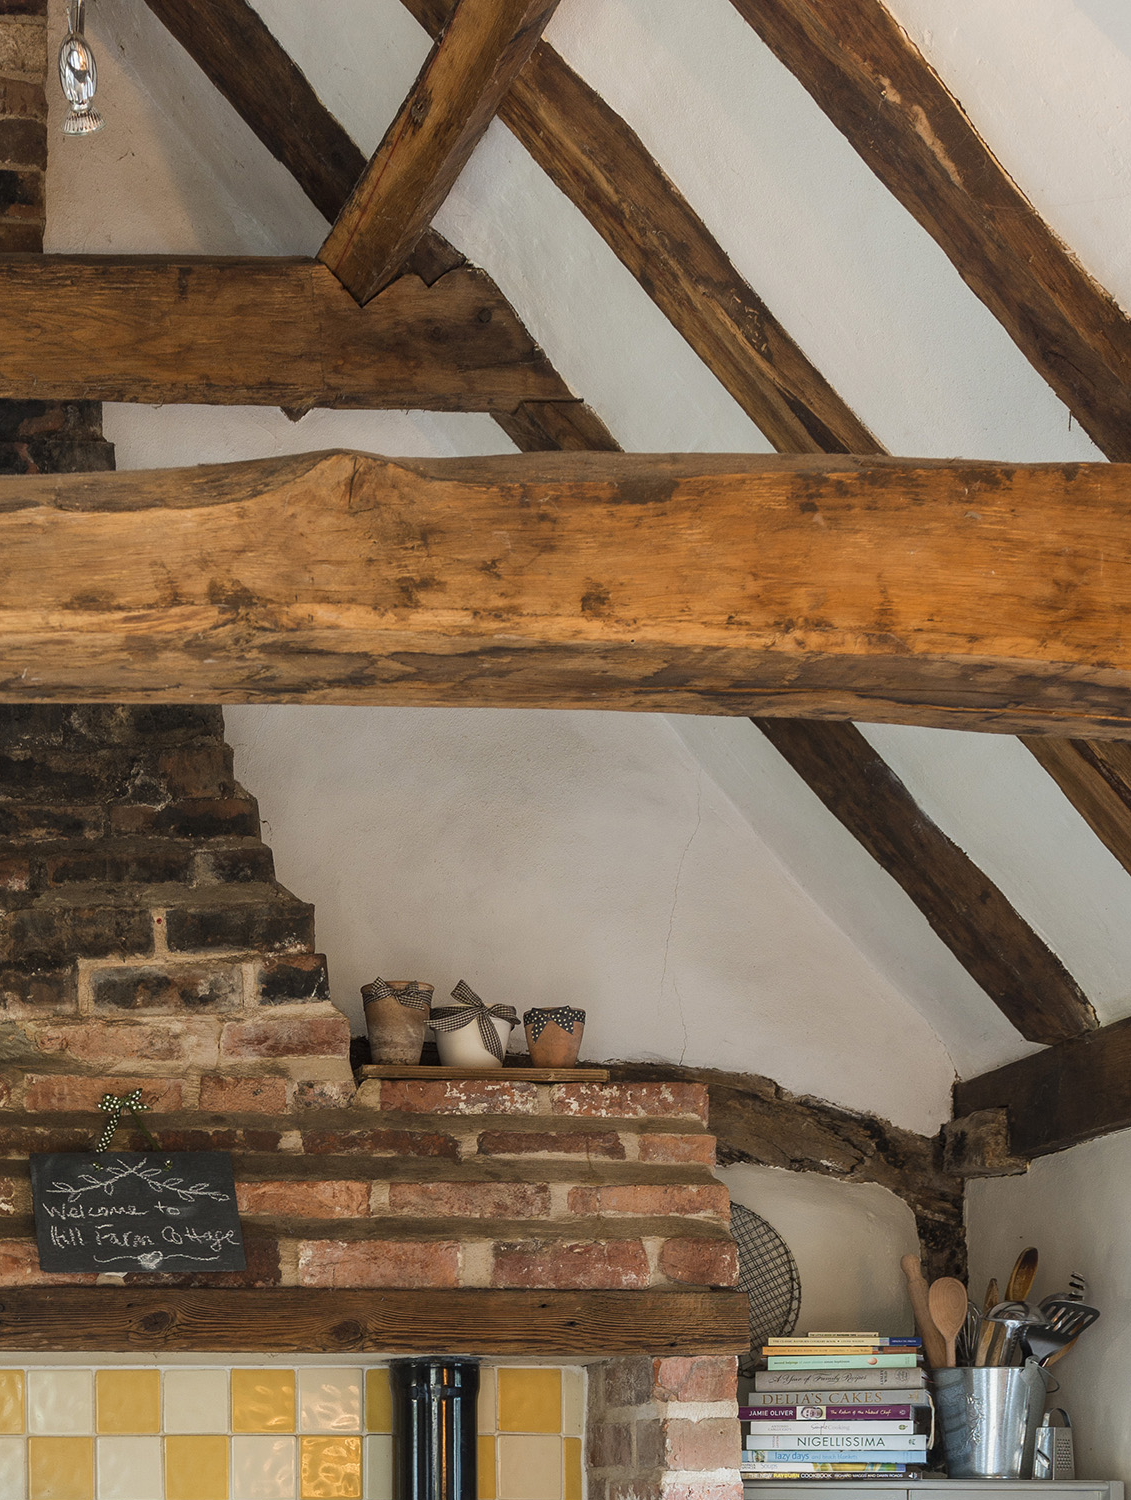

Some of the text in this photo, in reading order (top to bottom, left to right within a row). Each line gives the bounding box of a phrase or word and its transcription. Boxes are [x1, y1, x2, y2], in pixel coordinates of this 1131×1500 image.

[42, 1201, 181, 1220] Welcome to
[50, 1225, 86, 1249] Hill
[95, 1224, 155, 1247] Farm
[769, 1374, 782, 1383] A
[804, 1375, 811, 1384] of
[762, 1392, 882, 1405] DELIA'S CAKES
[797, 1437, 885, 1447] NIGELLISSIMA
[775, 1452, 789, 1461] lazy
[792, 1452, 809, 1461] days
